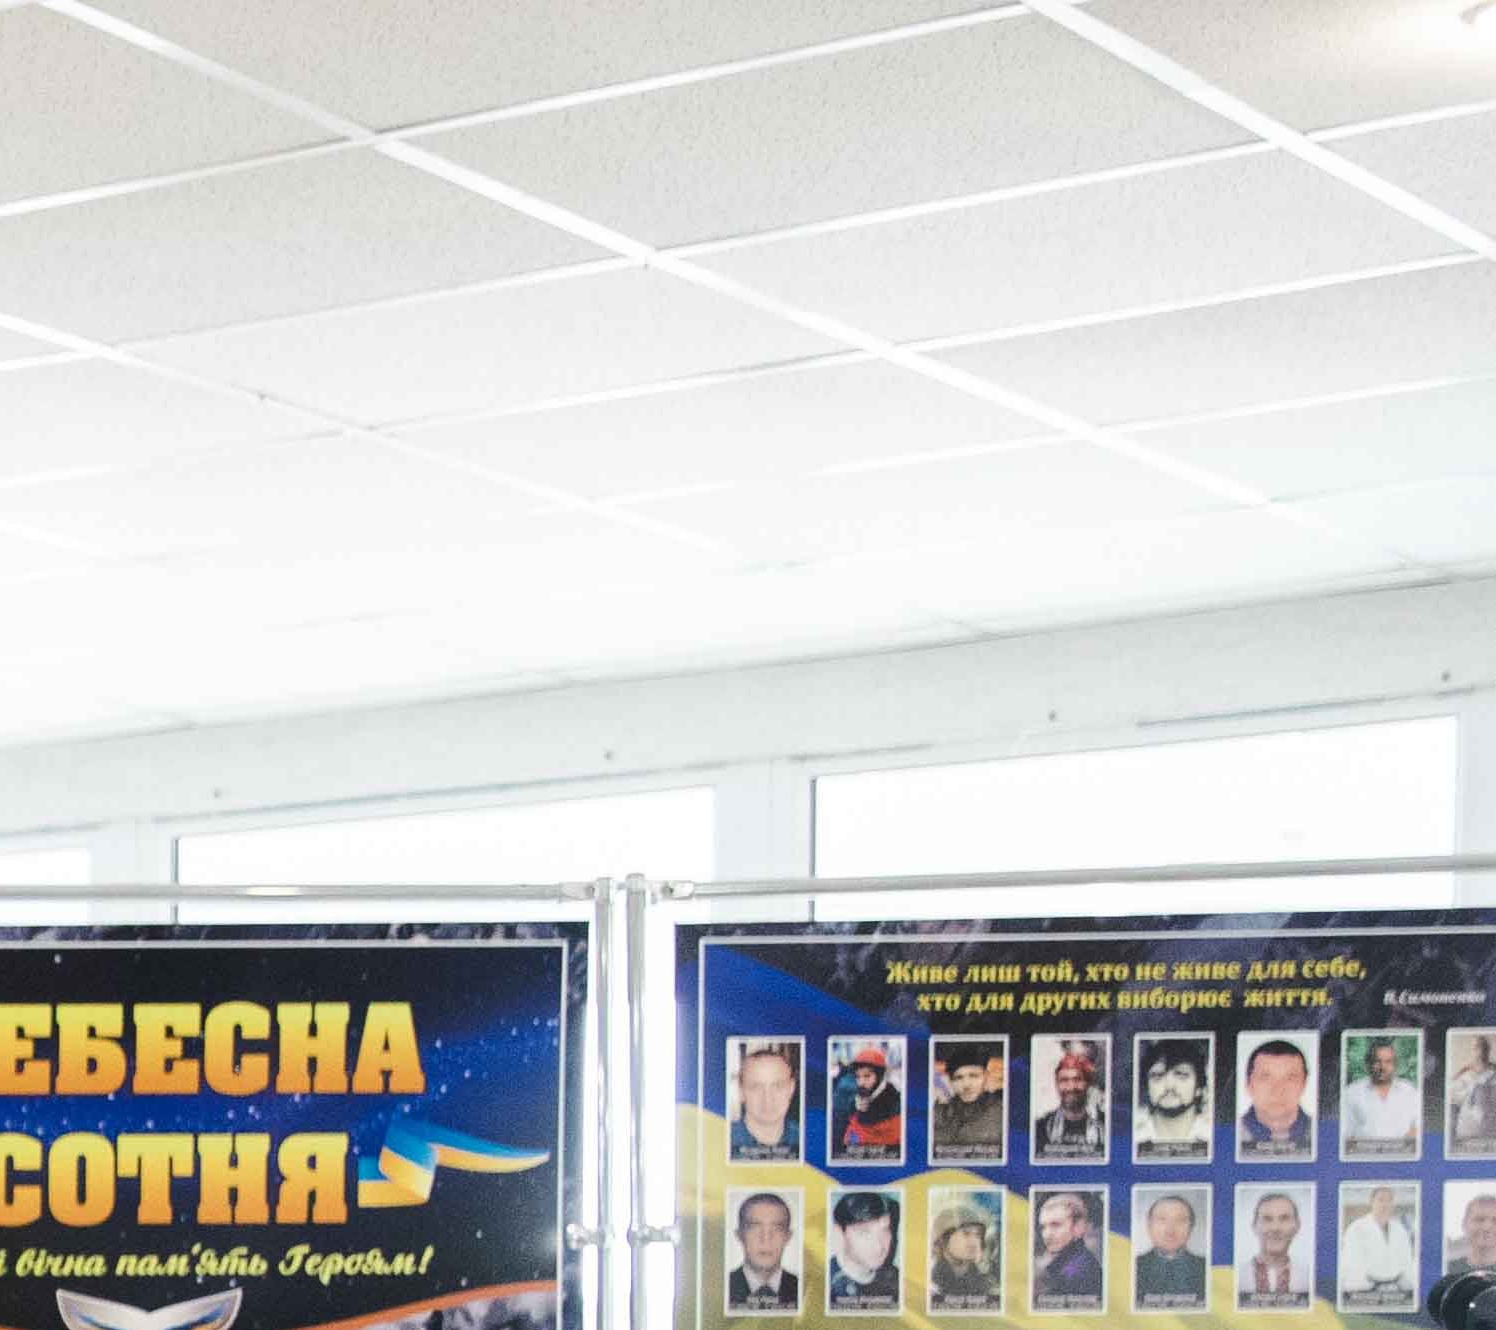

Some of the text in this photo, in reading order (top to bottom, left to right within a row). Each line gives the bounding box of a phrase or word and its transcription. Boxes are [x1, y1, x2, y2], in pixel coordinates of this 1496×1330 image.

[886, 955, 1367, 985] Живе лиш той, хто не живе для себе,
[917, 986, 1335, 1016] хто для других виборює життя.
[15, 1248, 107, 1278] вічна
[278, 1243, 435, 1287] Героям!
